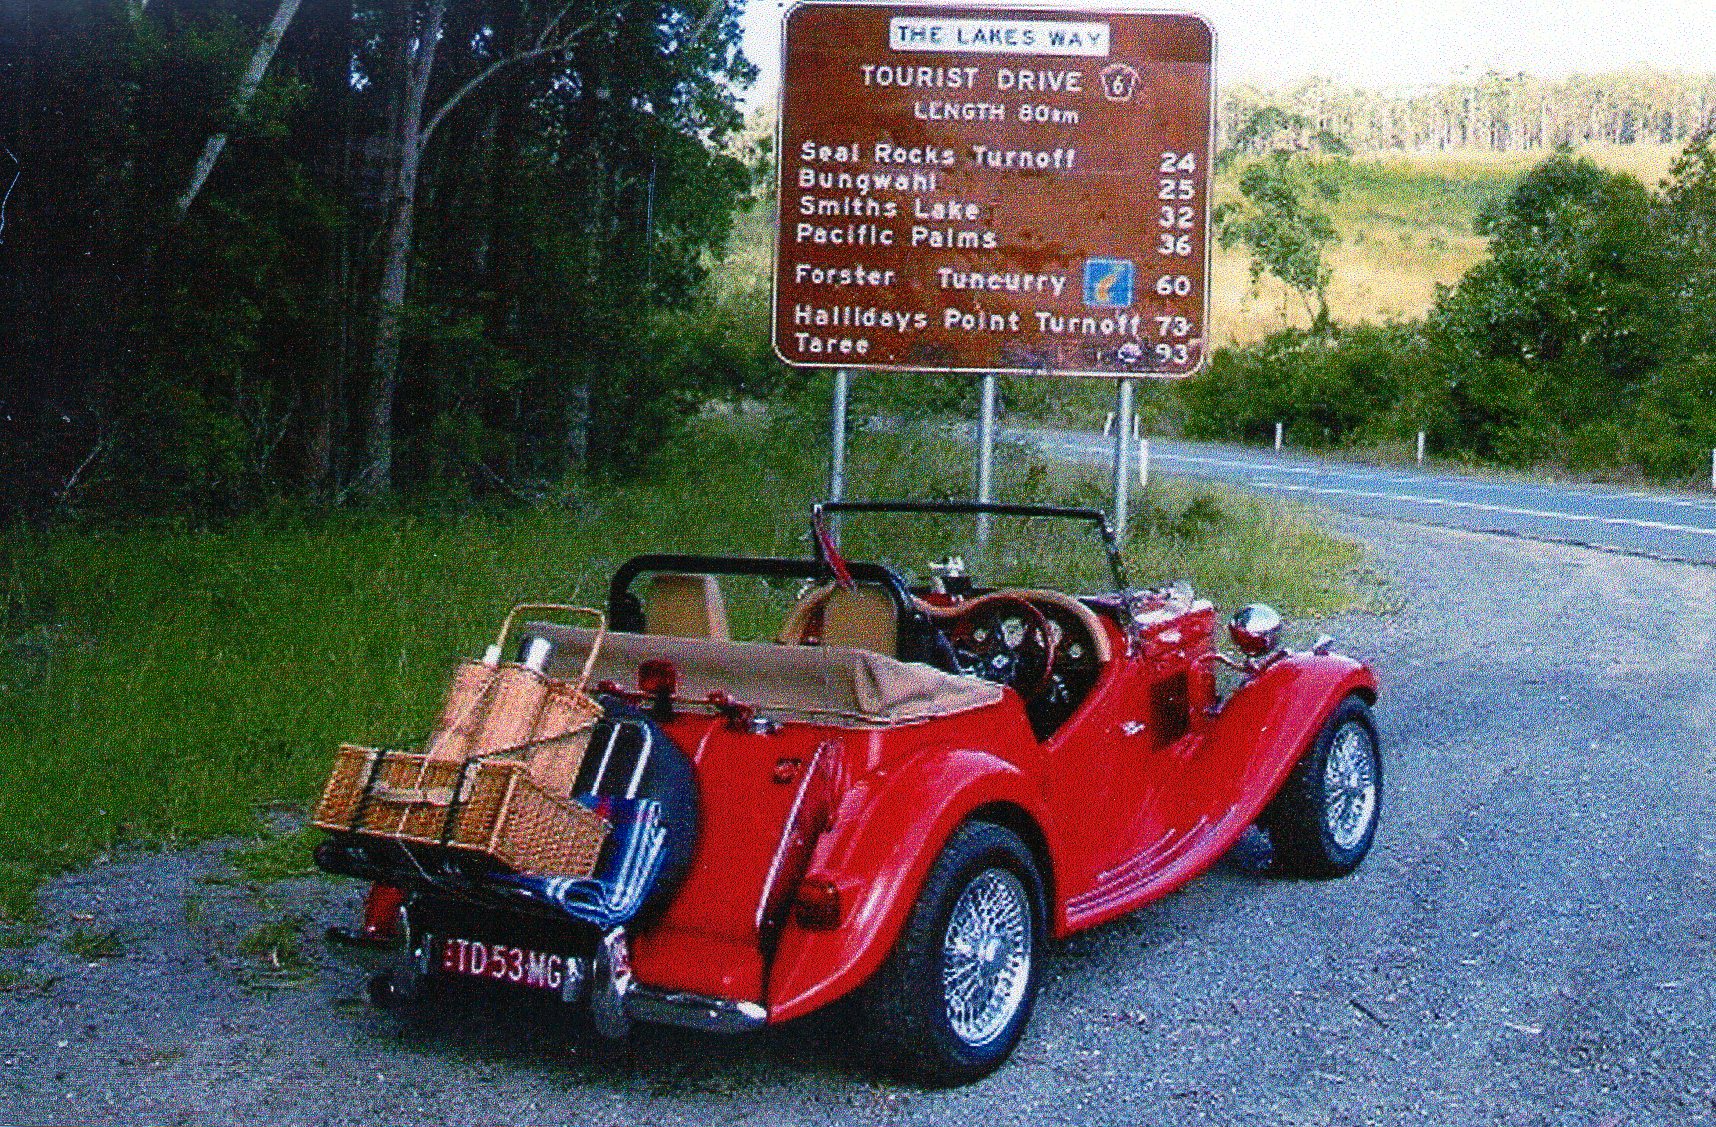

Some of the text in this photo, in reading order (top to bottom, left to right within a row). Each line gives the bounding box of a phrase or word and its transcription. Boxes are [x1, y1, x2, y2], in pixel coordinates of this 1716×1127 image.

[898, 26, 1101, 48] THE LAKES WAY
[861, 64, 1083, 92] TOURIST DRIVE
[1112, 76, 1124, 95] 6
[914, 101, 1005, 121] LENGTH
[800, 140, 1197, 174] Seal Rocks Turnoff 24
[800, 168, 1195, 201] Bungwahl 25
[800, 196, 1195, 229] Smiths Lake 32
[797, 224, 1193, 256] Pacific Palms 36
[795, 265, 1192, 296] Forster Tuncurry 60
[795, 304, 1191, 337] Hallidays Point Turnoff 73
[796, 333, 1189, 364] Taree 93
